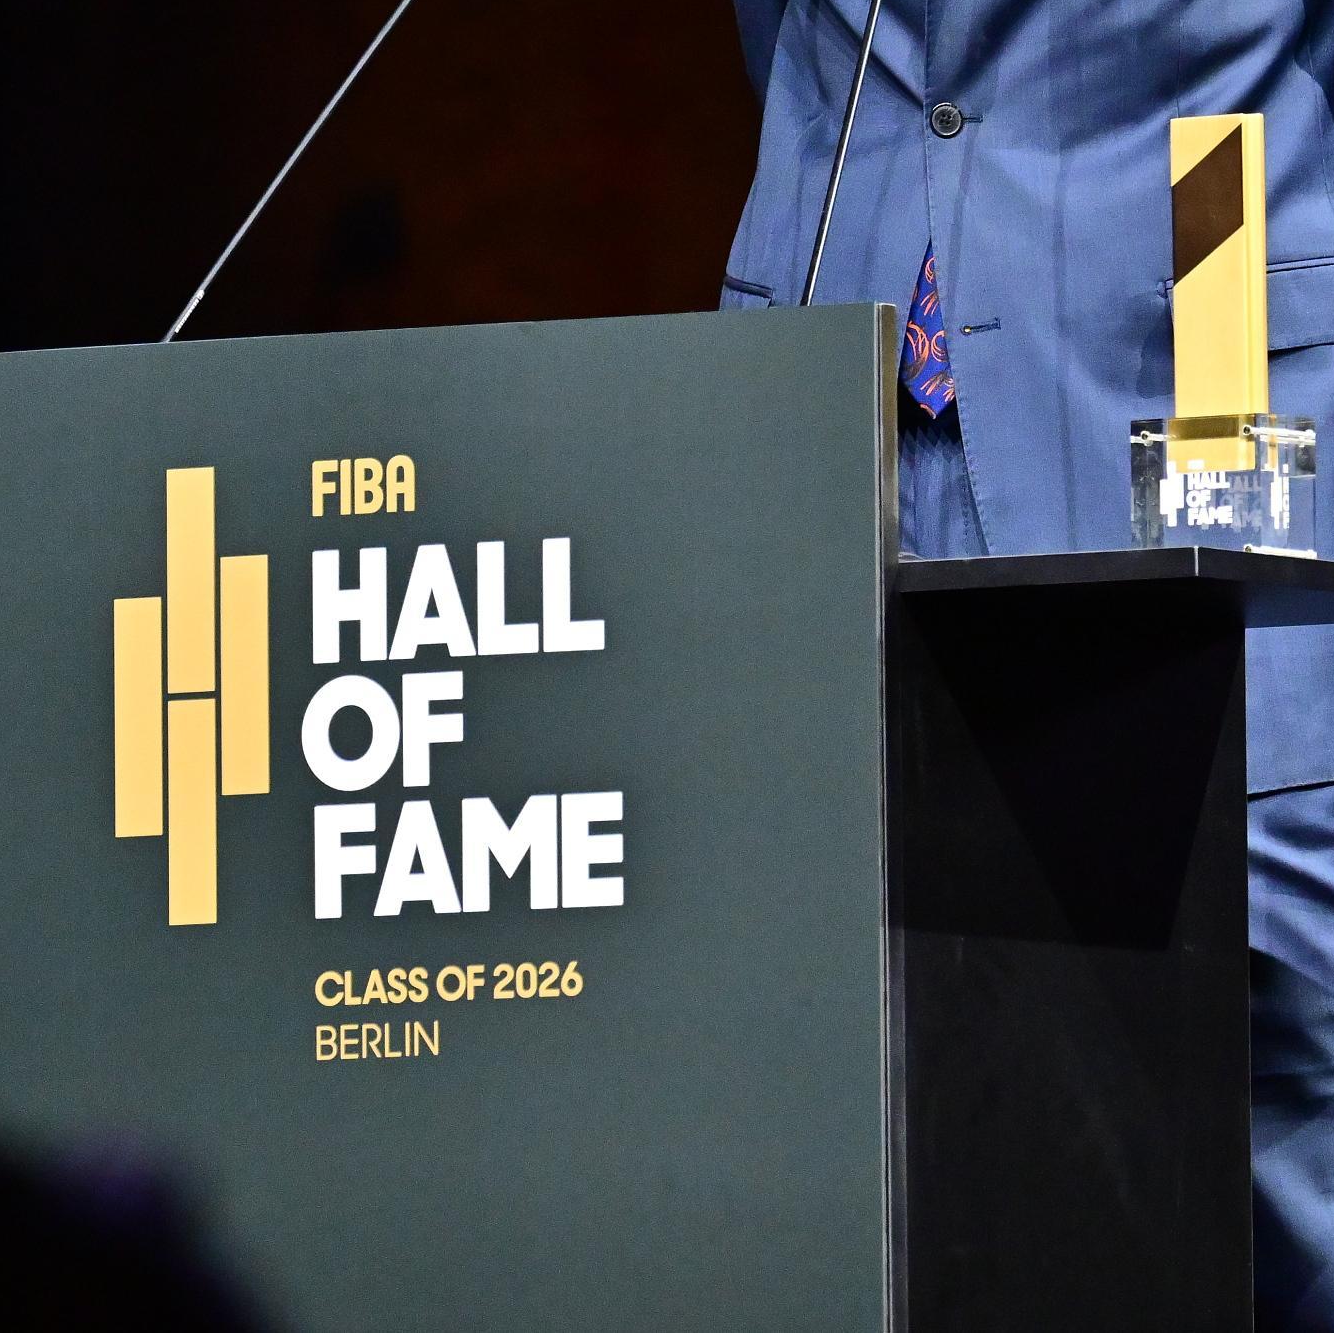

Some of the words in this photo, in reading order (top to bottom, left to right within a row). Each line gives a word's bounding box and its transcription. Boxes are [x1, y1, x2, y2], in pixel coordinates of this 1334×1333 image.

[312, 454, 415, 516] FIBA
[1186, 490, 1211, 508] OF
[1187, 471, 1230, 490] HALL
[1188, 506, 1233, 526] FAME
[312, 537, 605, 664] HALL
[301, 670, 463, 792] OF
[314, 791, 624, 919] FAME
[314, 967, 429, 1007] CLASS
[436, 965, 485, 1002] OF
[493, 961, 584, 1000] 2026
[315, 1020, 440, 1061] BERLIN
